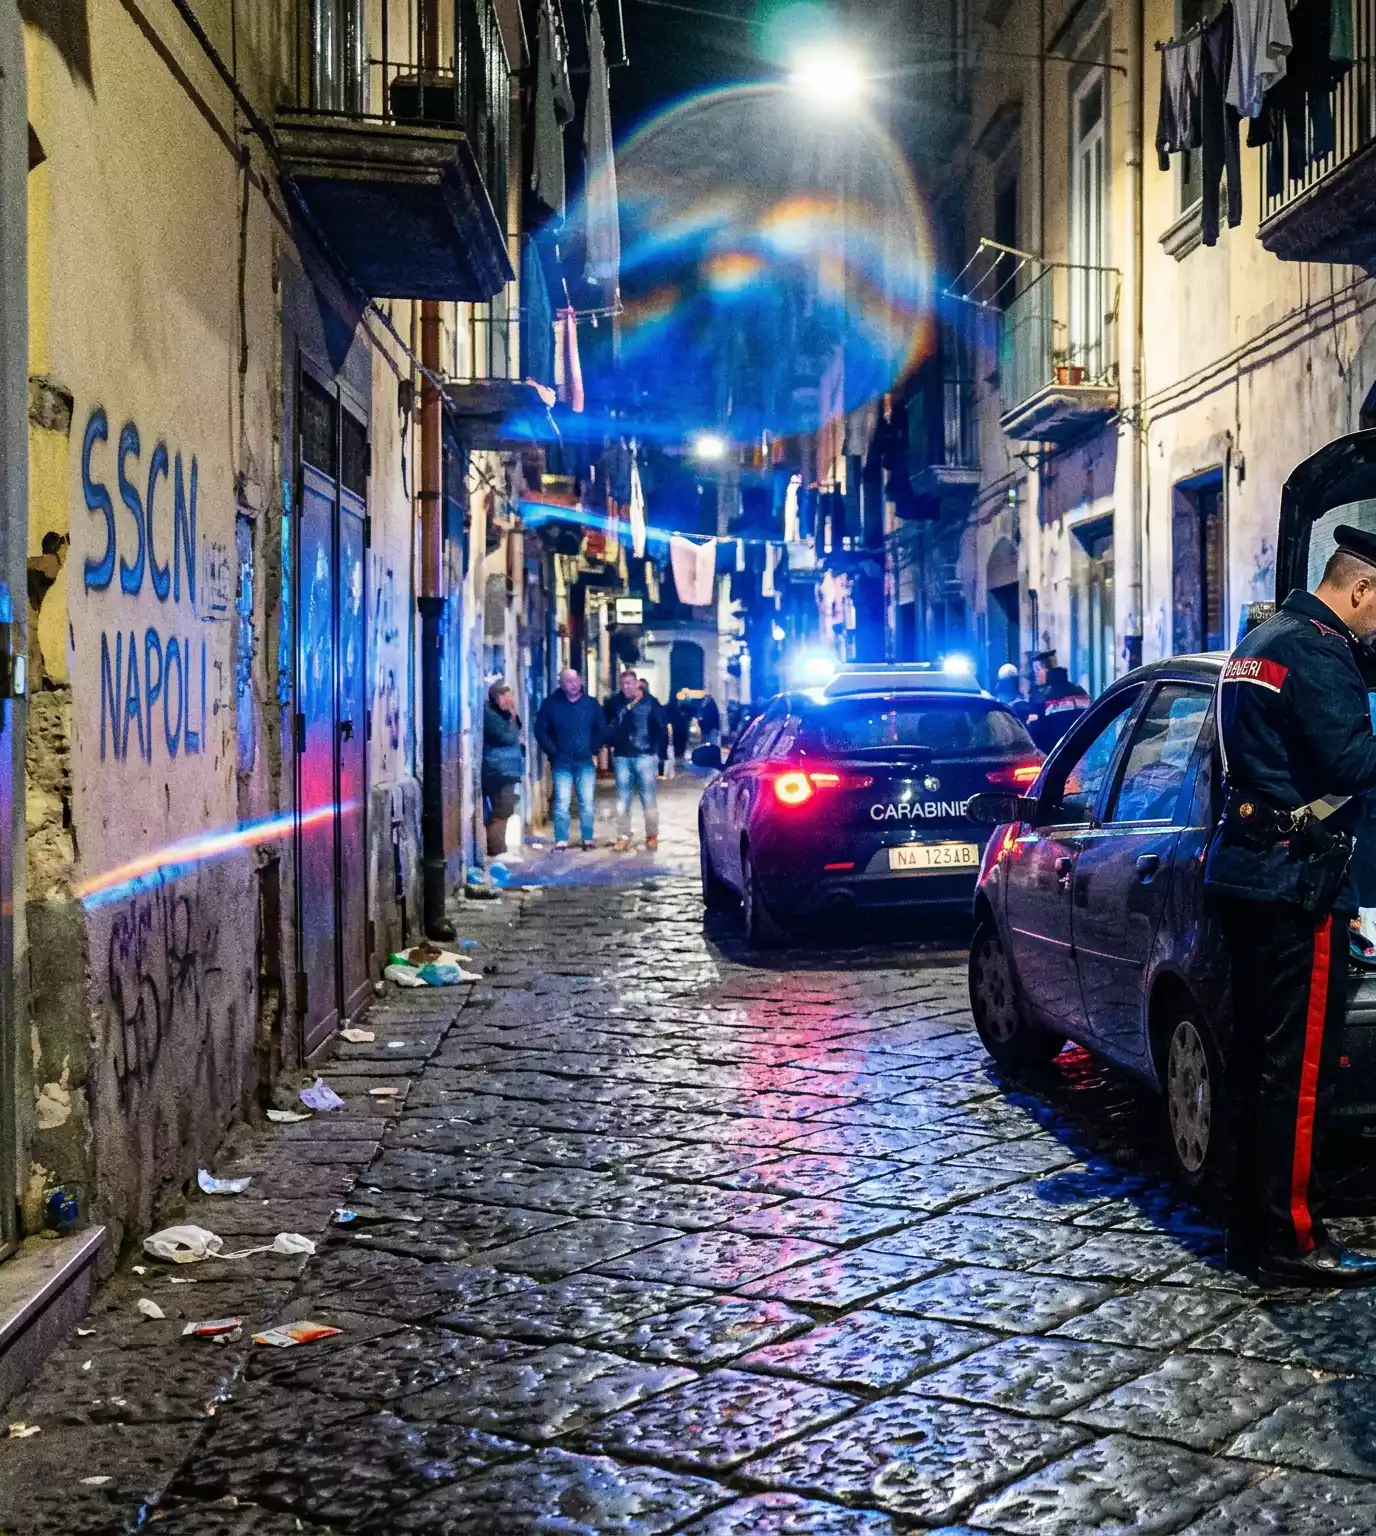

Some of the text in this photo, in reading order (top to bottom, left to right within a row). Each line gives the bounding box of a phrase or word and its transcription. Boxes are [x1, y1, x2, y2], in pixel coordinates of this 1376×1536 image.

[81, 405, 198, 614] SSCN
[101, 627, 206, 763] NAPOLI
[870, 801, 968, 820] CARABINIE
[898, 848, 971, 865] NA 123AB
